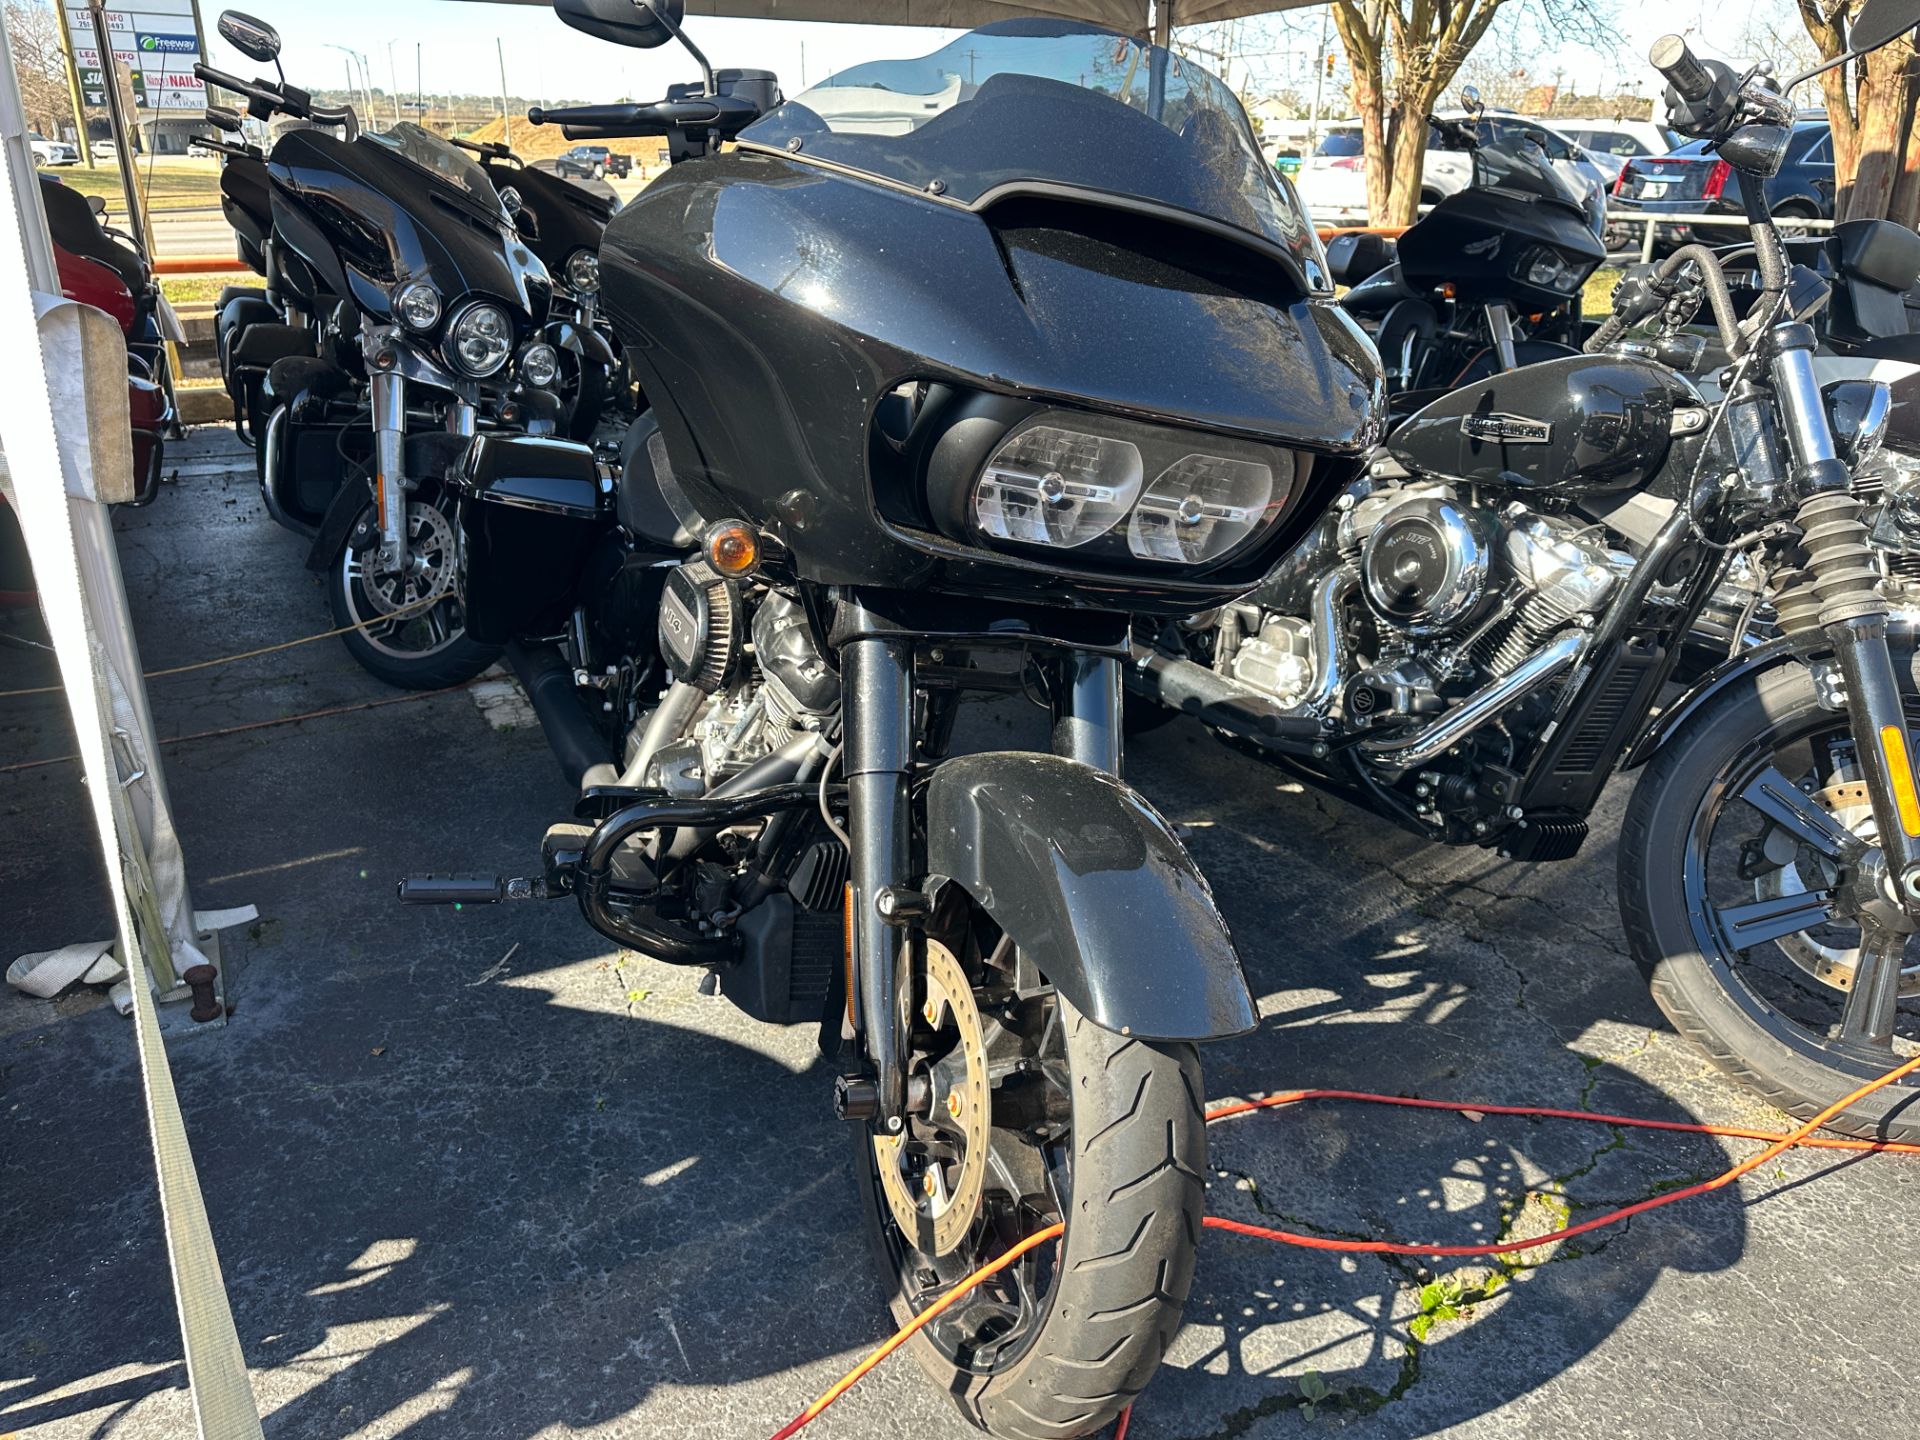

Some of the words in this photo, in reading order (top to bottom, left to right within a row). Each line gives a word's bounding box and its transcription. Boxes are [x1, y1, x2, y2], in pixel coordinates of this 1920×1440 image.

[155, 37, 195, 50] Freeway
[169, 75, 203, 88] NAILS
[1406, 532, 1432, 545] 117
[667, 609, 682, 633] 114
